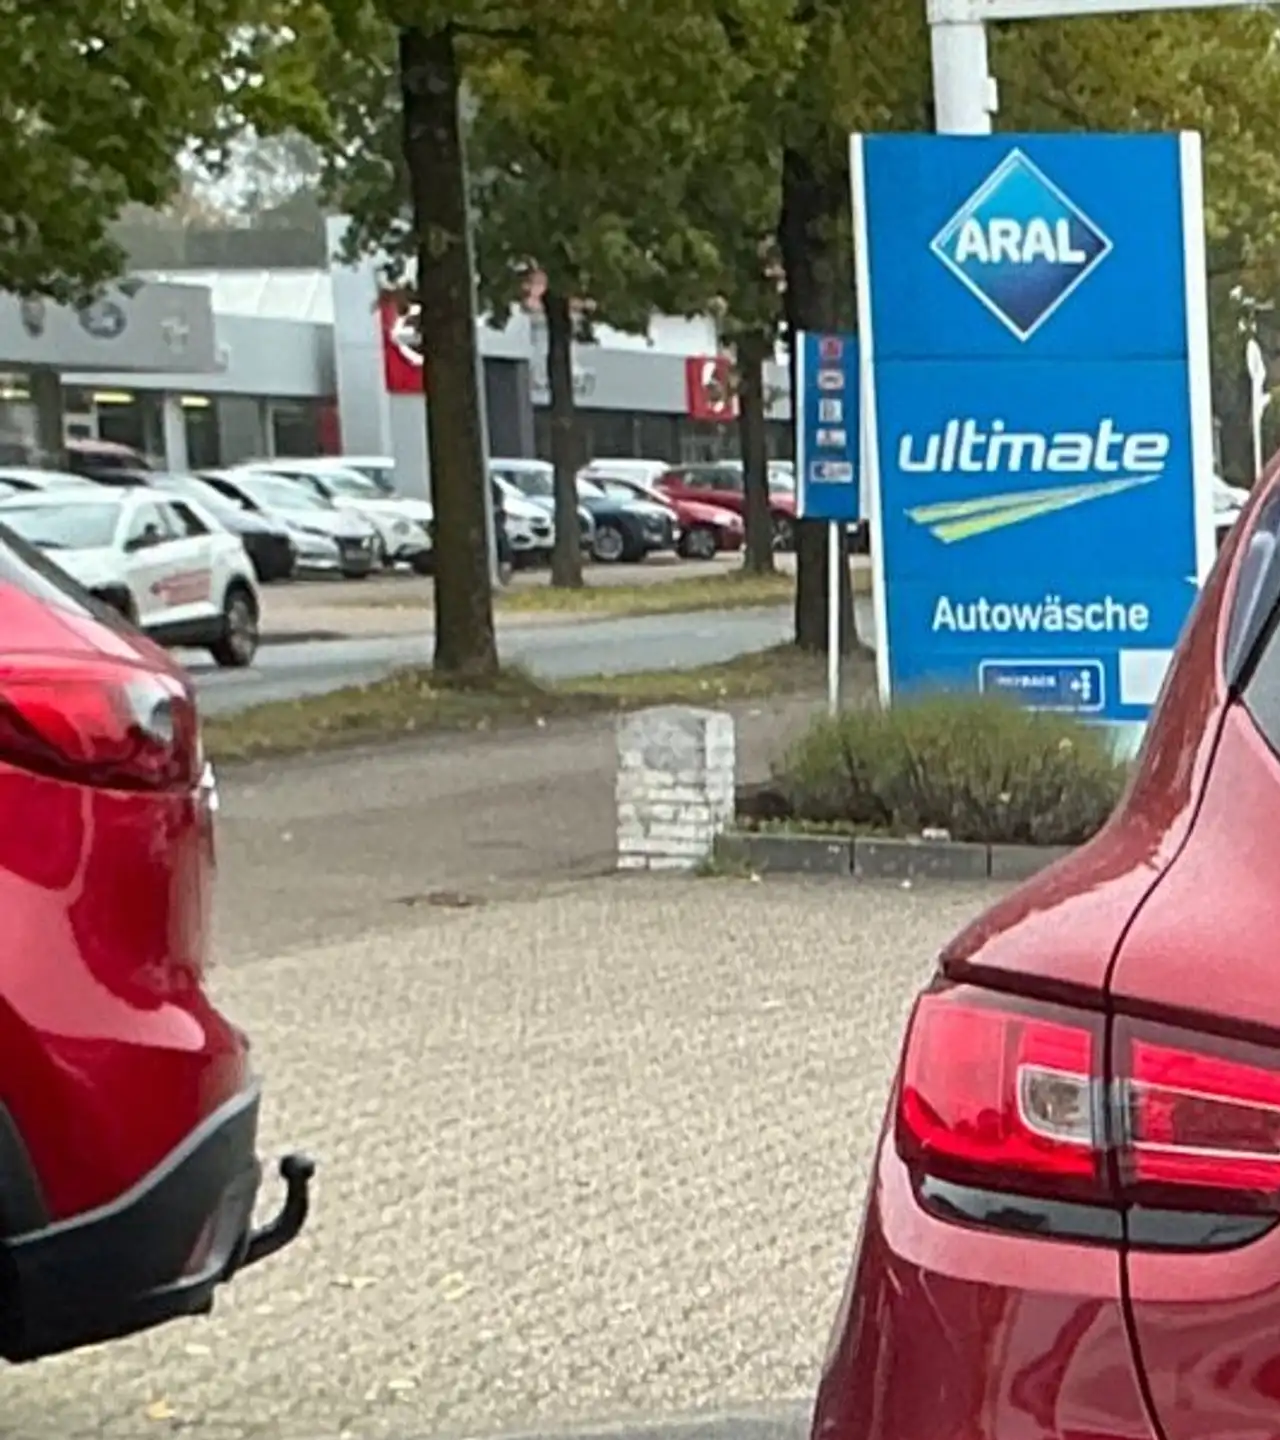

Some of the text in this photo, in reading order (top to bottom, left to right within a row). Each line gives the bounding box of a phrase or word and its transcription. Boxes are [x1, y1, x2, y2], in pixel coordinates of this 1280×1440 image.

[954, 217, 1087, 267] ARAL
[898, 418, 1171, 473] ultimate
[932, 594, 1150, 632] Autowäsche
